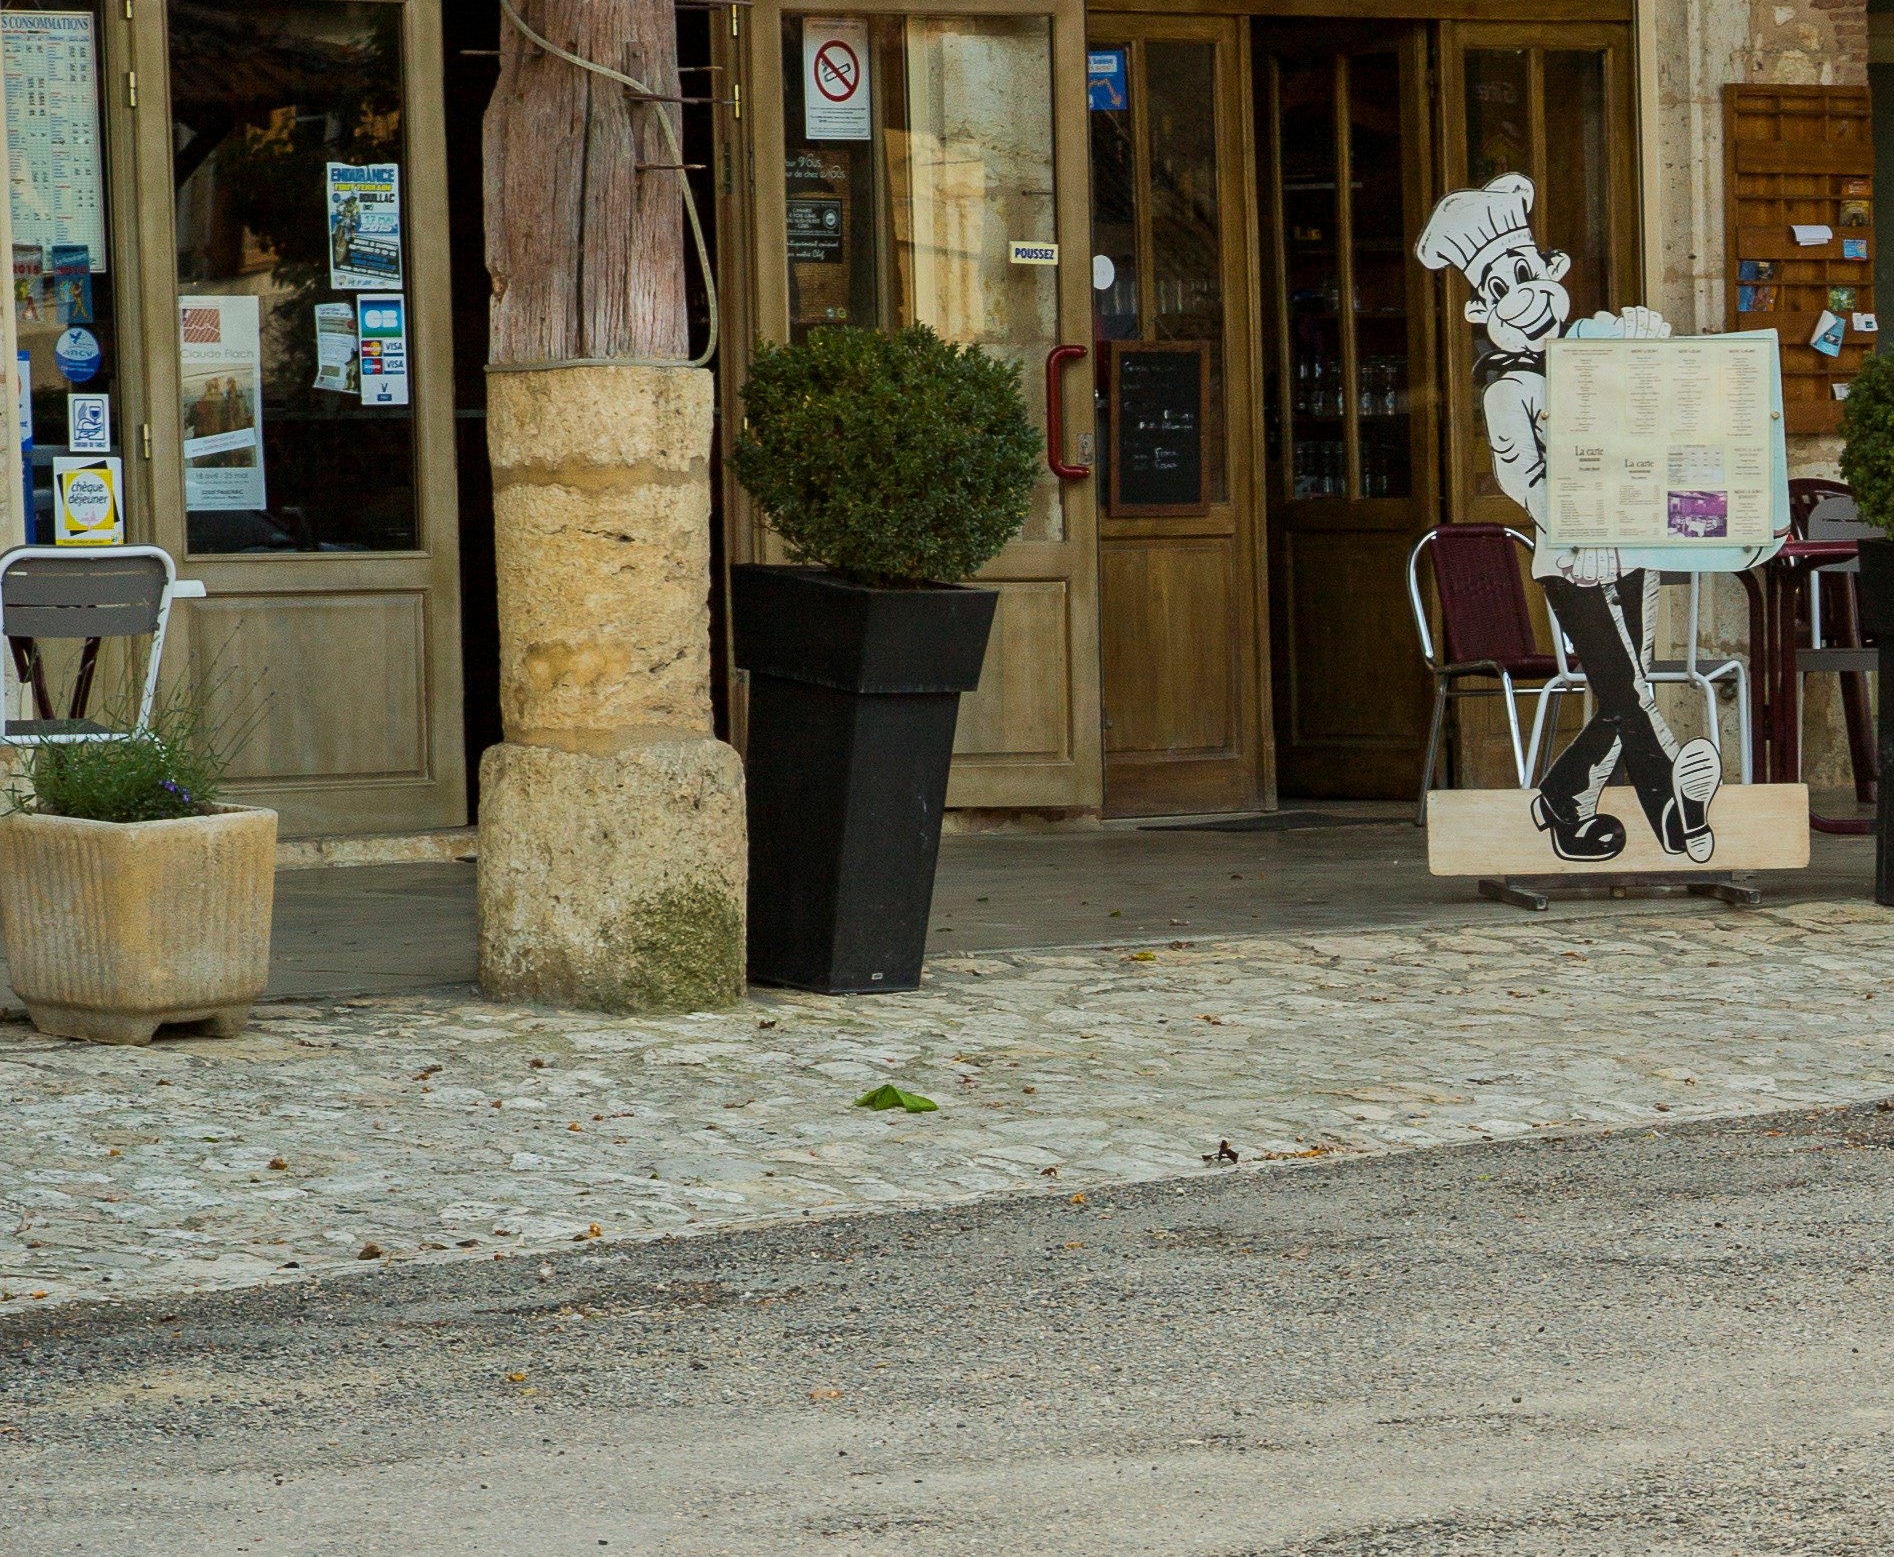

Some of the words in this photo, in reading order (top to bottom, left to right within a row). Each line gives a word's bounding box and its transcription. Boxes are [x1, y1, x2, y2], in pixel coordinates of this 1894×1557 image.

[9, 17, 89, 30] CONSOMMATIONS
[331, 168, 395, 182] ENDURANCE
[359, 193, 395, 203] BOUILLAC
[1015, 248, 1055, 260] POUSSEZ
[386, 342, 403, 351] VISA
[182, 349, 222, 359] Claude
[387, 361, 404, 369] VISA
[71, 481, 104, 495] chèque
[68, 493, 108, 506] déjeuner
